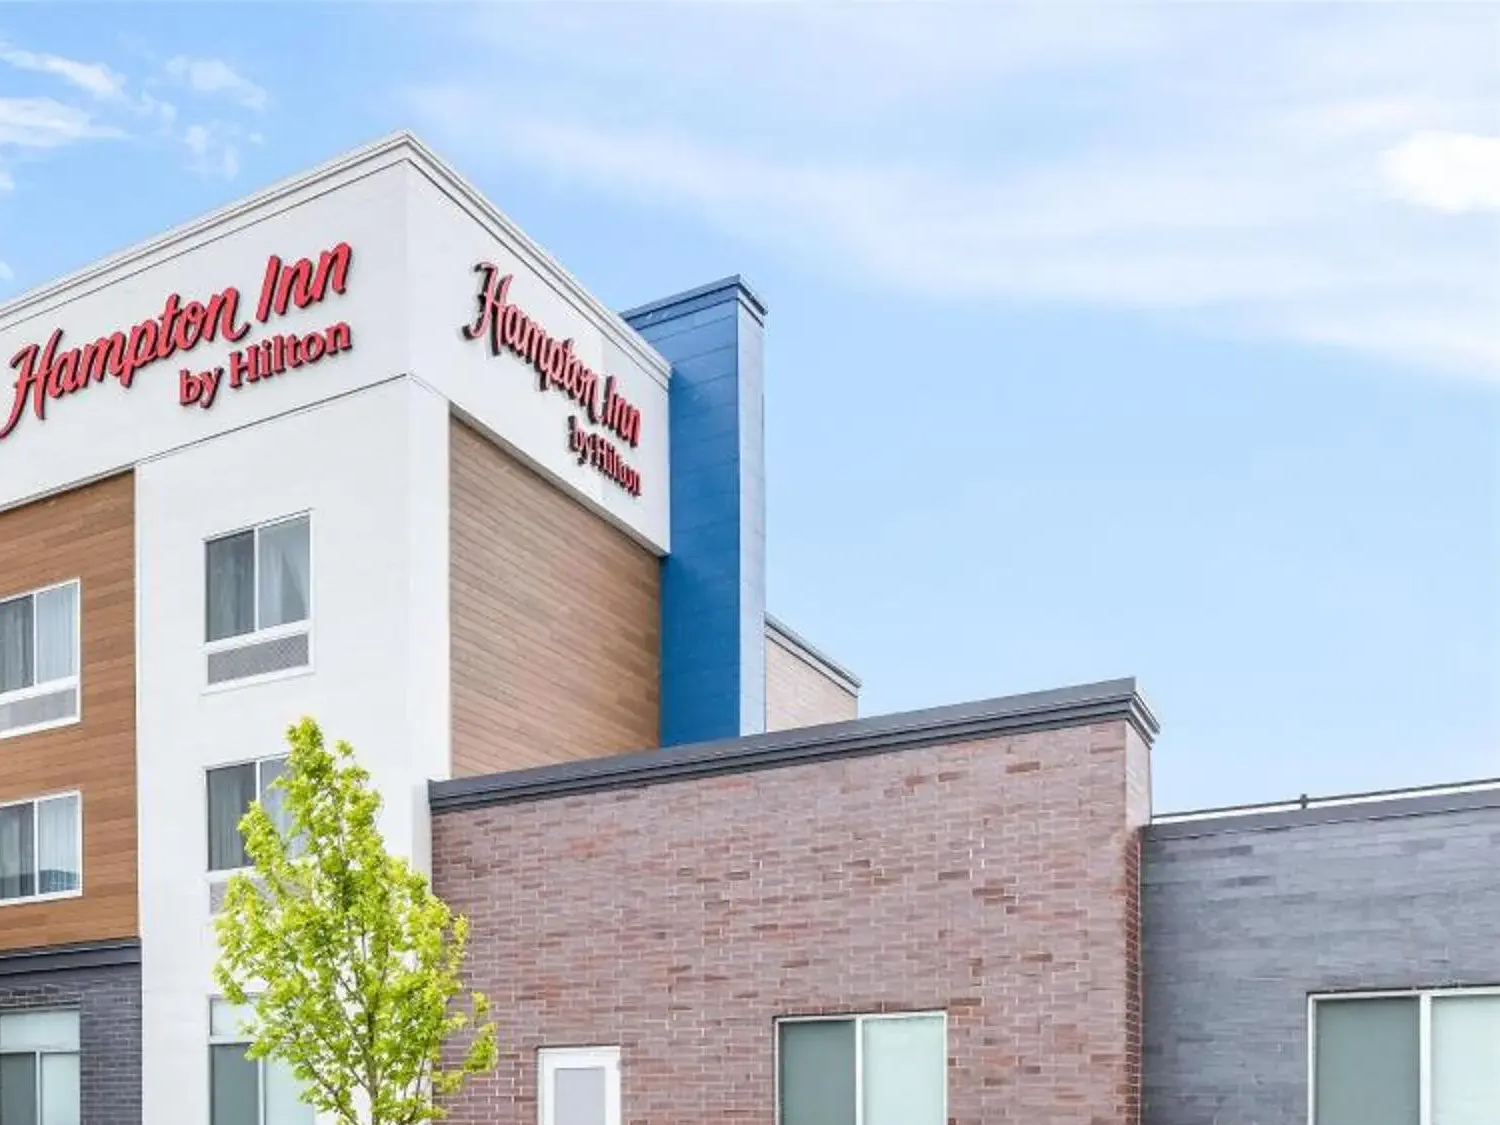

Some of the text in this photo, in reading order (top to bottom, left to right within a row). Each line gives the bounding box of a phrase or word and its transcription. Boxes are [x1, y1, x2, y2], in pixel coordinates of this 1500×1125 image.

[256, 241, 353, 323] Inn
[178, 320, 353, 409] by Hilton
[464, 261, 641, 447] Hampton Inn
[568, 415, 641, 496] by Hilton
